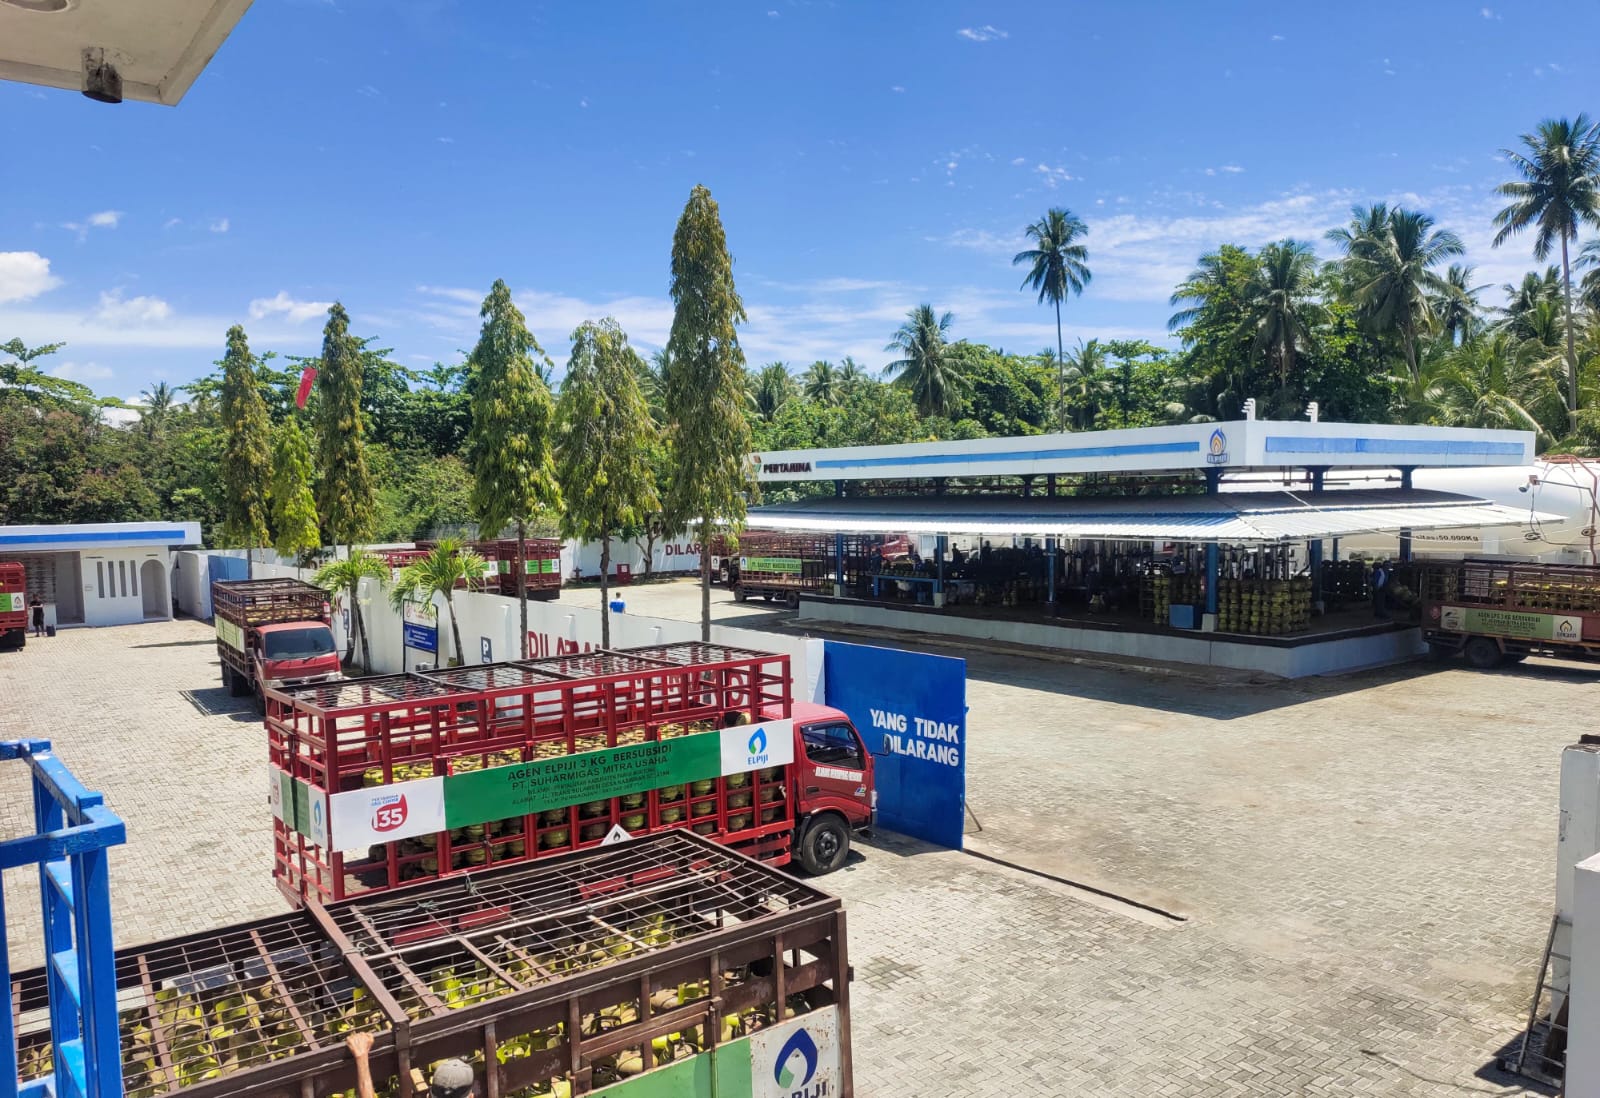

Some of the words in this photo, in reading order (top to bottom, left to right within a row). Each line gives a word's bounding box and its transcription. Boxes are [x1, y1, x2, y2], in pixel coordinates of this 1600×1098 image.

[763, 462, 812, 474] PERTAMINA
[665, 543, 701, 556] DILAR
[528, 630, 600, 657] DILAR
[870, 708, 907, 733] YANG
[914, 717, 959, 744] TIDAK
[508, 767, 541, 780] AGEN
[545, 761, 577, 774] ELPIJI
[580, 759, 587, 768] 3
[590, 756, 606, 766] KG
[613, 744, 672, 762] BERSUBSIDI
[747, 753, 769, 765] ELPIJI
[883, 733, 959, 767] DILARANG
[530, 767, 600, 787] SUHARMIGAS
[603, 762, 633, 774] MITRA
[635, 755, 668, 768] USAHA
[789, 1081, 827, 1098] PIJI
